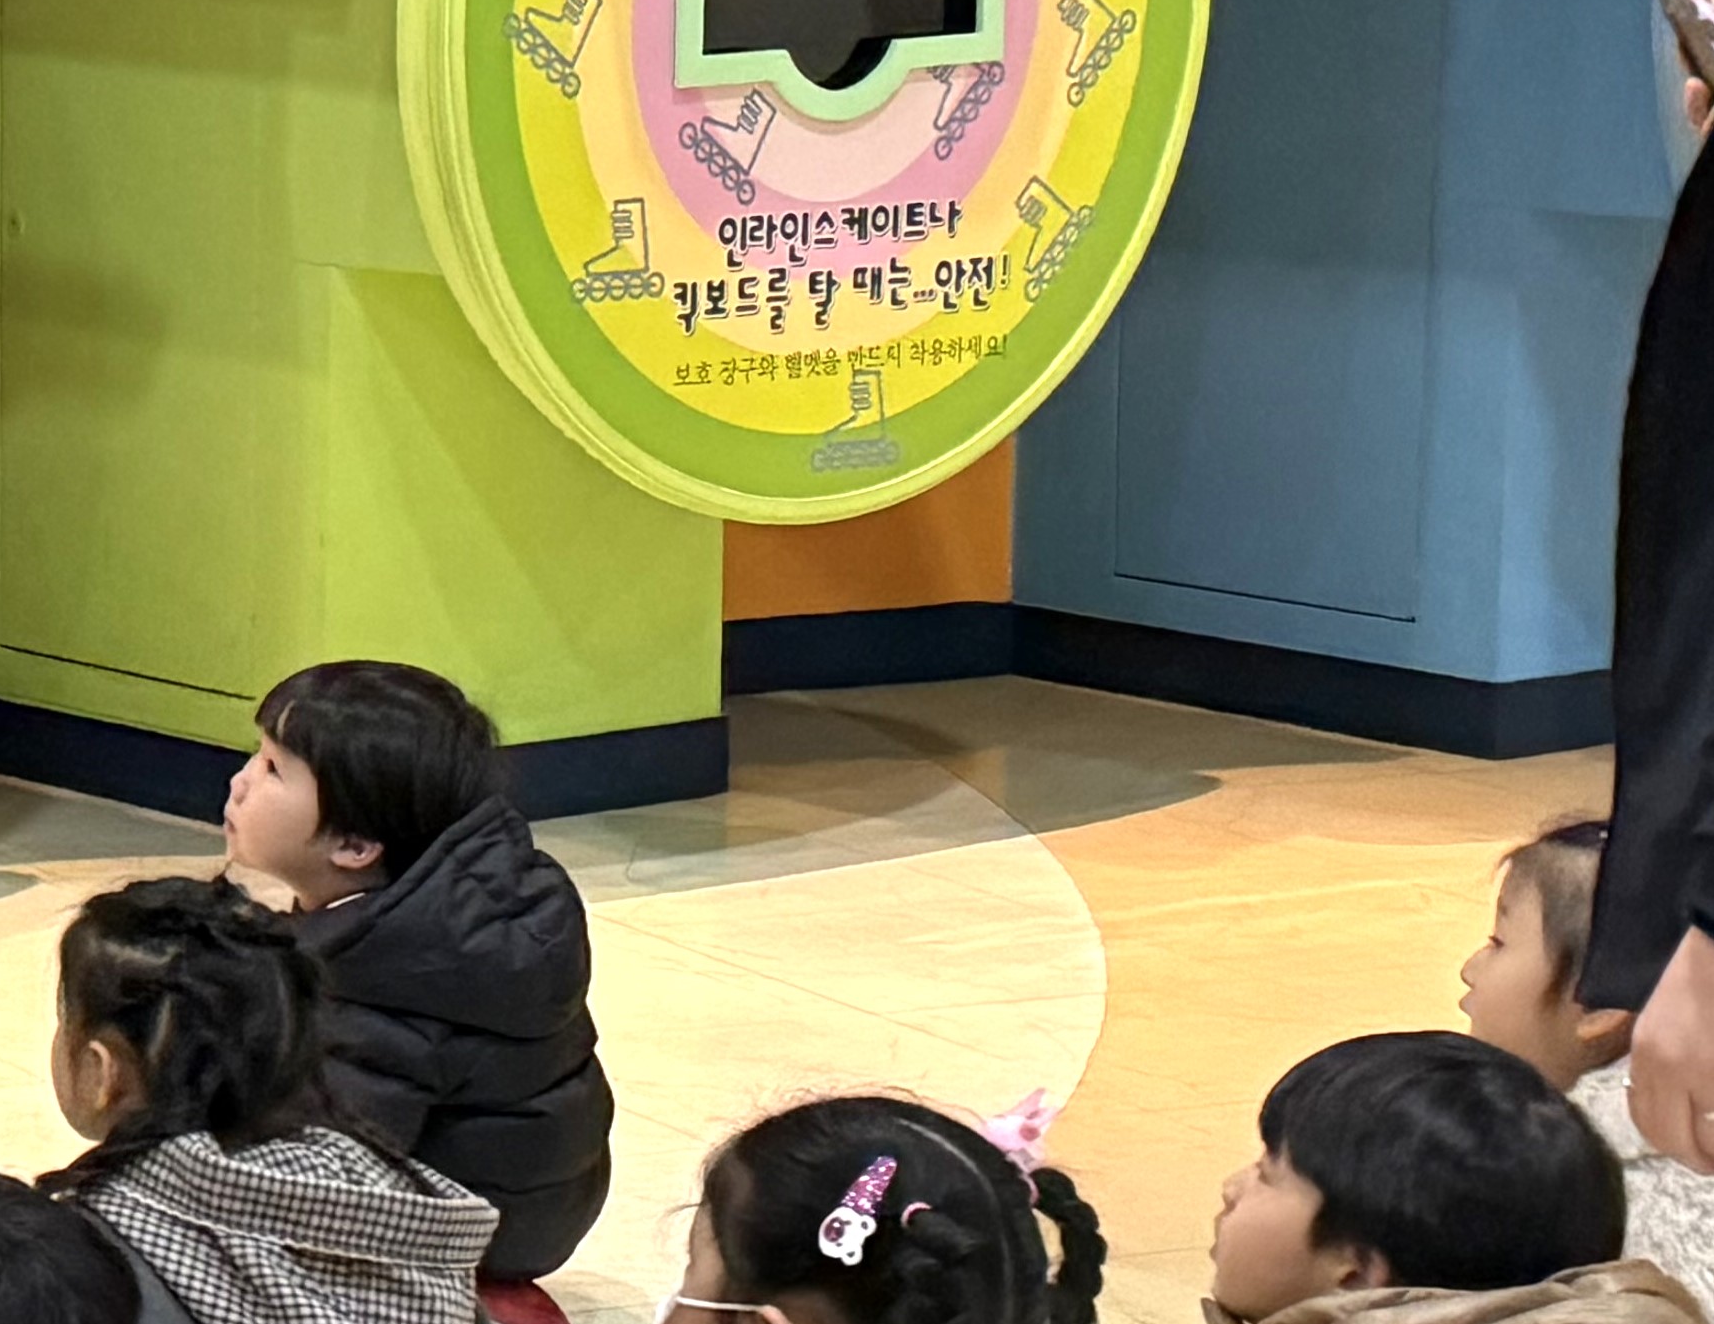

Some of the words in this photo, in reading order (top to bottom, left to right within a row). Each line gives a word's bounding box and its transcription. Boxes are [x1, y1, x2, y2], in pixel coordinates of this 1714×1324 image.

[718, 200, 962, 271] 인라인스케이트나
[673, 268, 790, 336] 킥보드를
[809, 270, 841, 330] 탈
[673, 361, 712, 386] 보호
[719, 354, 779, 386] 장구와
[784, 347, 841, 379] 헬멧을
[910, 333, 1007, 366] 착용하세요!
